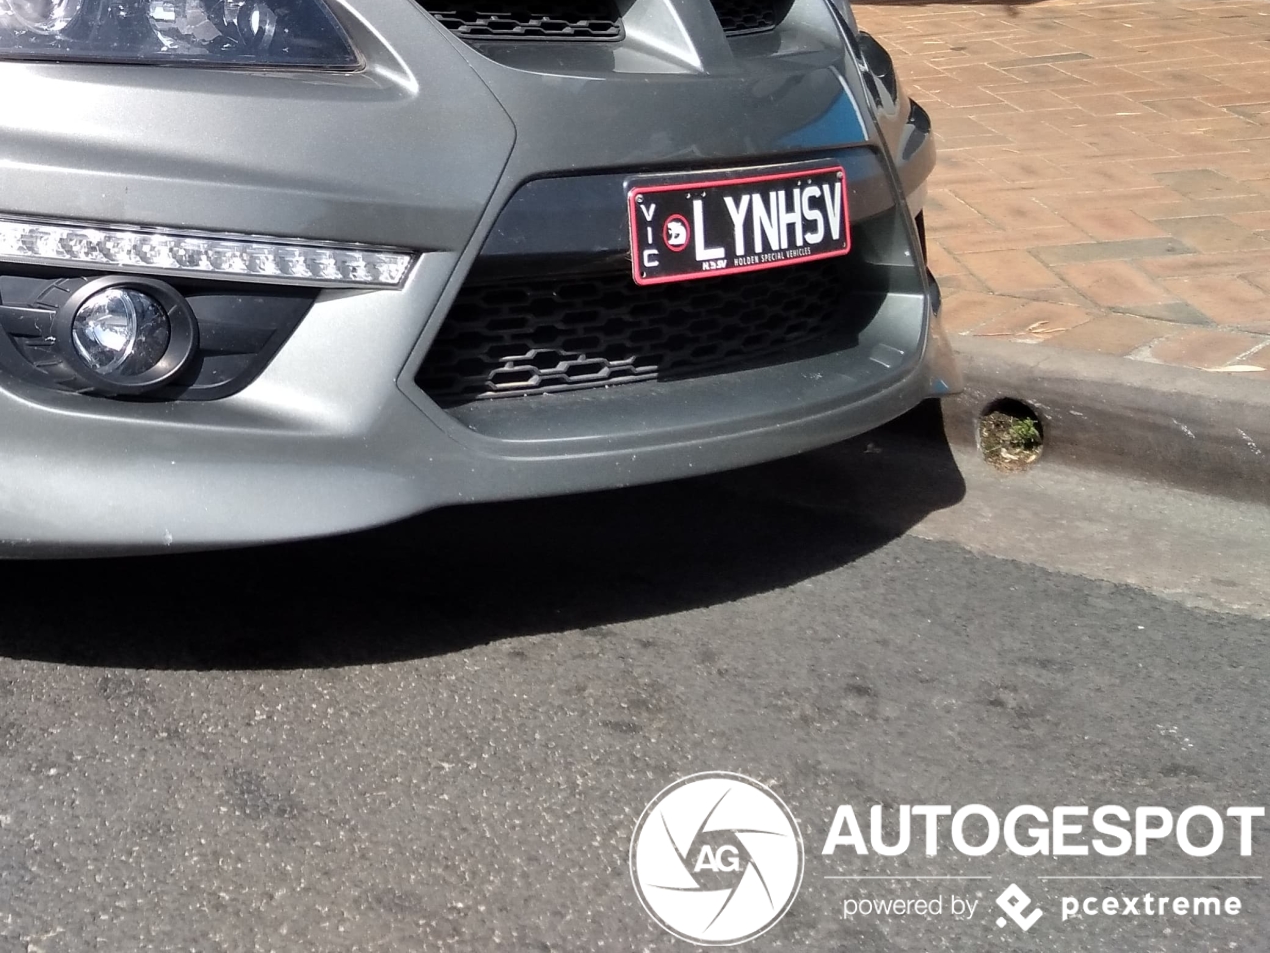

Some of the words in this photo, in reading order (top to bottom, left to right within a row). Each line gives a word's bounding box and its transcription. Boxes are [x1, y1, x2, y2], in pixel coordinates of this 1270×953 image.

[639, 203, 660, 268] VIC
[693, 182, 842, 261] LYNHSV
[733, 255, 759, 267] HOLDEN
[761, 251, 785, 263] SPECIAL
[786, 246, 812, 259] VEHICLES
